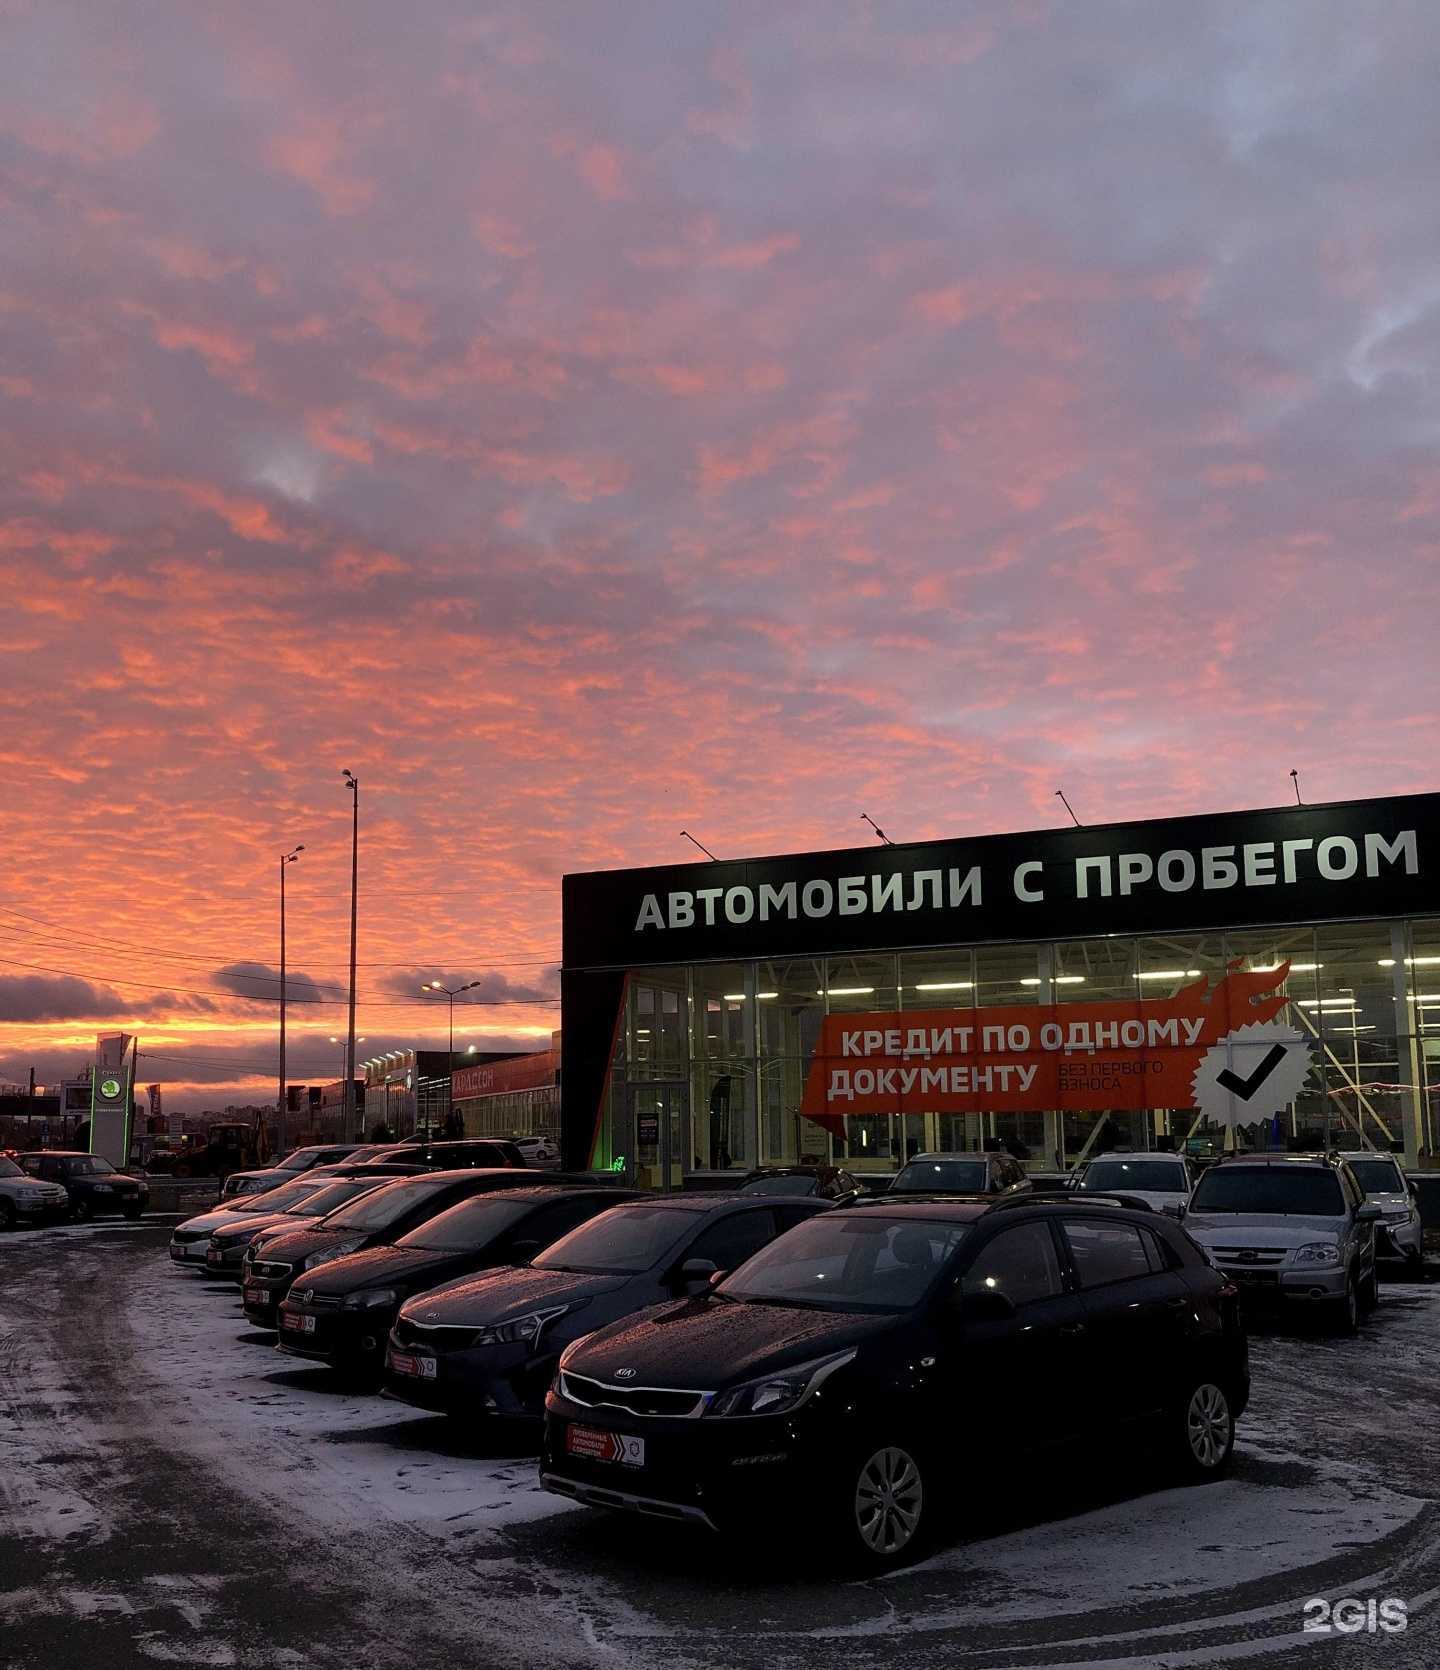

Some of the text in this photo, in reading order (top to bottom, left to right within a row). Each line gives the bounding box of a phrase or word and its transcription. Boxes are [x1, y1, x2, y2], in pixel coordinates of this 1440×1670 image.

[634, 830, 1420, 932] АВТОМОБИЛИ С ПРОБЕГОМ
[841, 1017, 1206, 1060] КРЕДИТ ПО ОДНОМУ
[827, 1063, 1039, 1101] ДОКУМЕНТУ
[1057, 1060, 1164, 1077] БЕЗ ПЕРВОГО
[1057, 1077, 1121, 1091] ВЗНОСА
[615, 1367, 635, 1379] KIA
